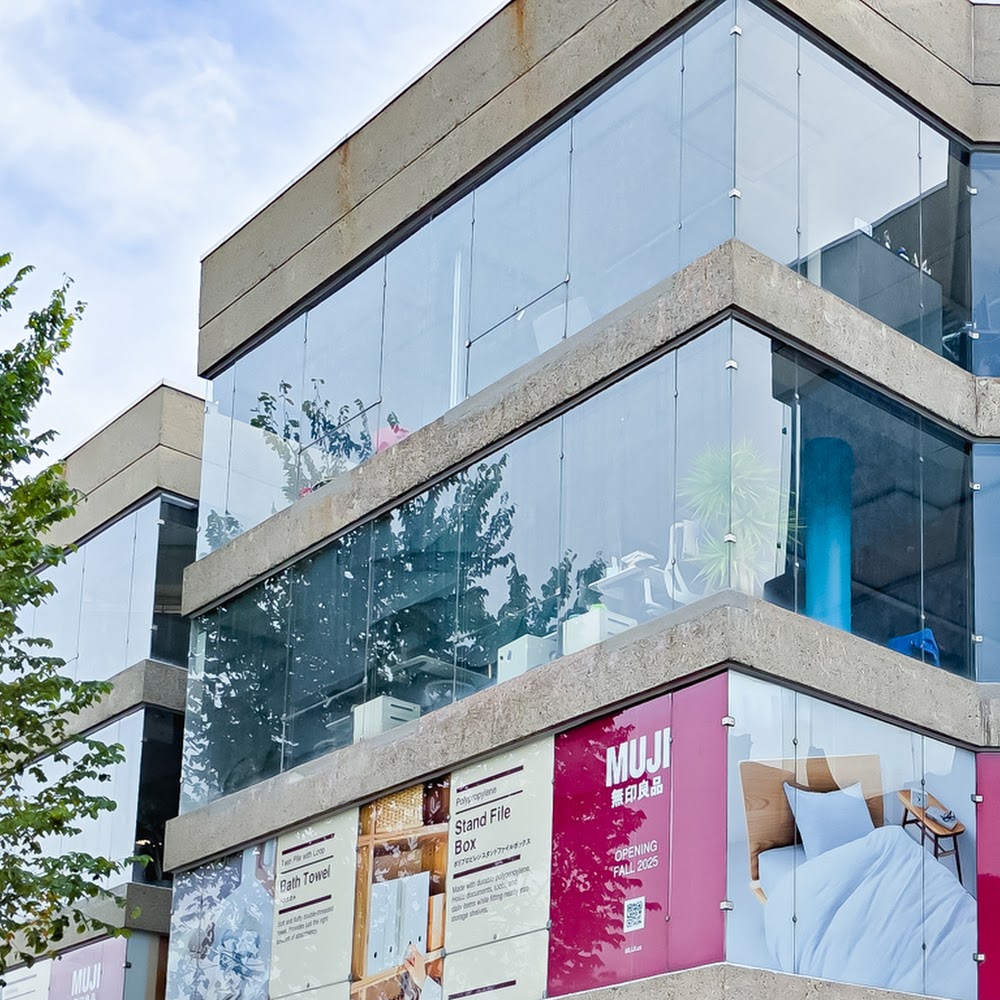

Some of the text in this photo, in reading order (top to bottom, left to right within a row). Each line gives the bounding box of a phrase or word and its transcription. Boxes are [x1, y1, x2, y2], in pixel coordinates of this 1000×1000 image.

[606, 727, 671, 788] MUJI
[456, 787, 497, 807] Polypropylene
[610, 775, 663, 808] 無印良品
[455, 806, 511, 835] Stand File
[455, 838, 476, 855] Box
[615, 840, 658, 862] OPENING
[280, 864, 331, 893] Bath Towel
[613, 856, 658, 878] FALL 2025
[71, 962, 101, 996] MUJI
